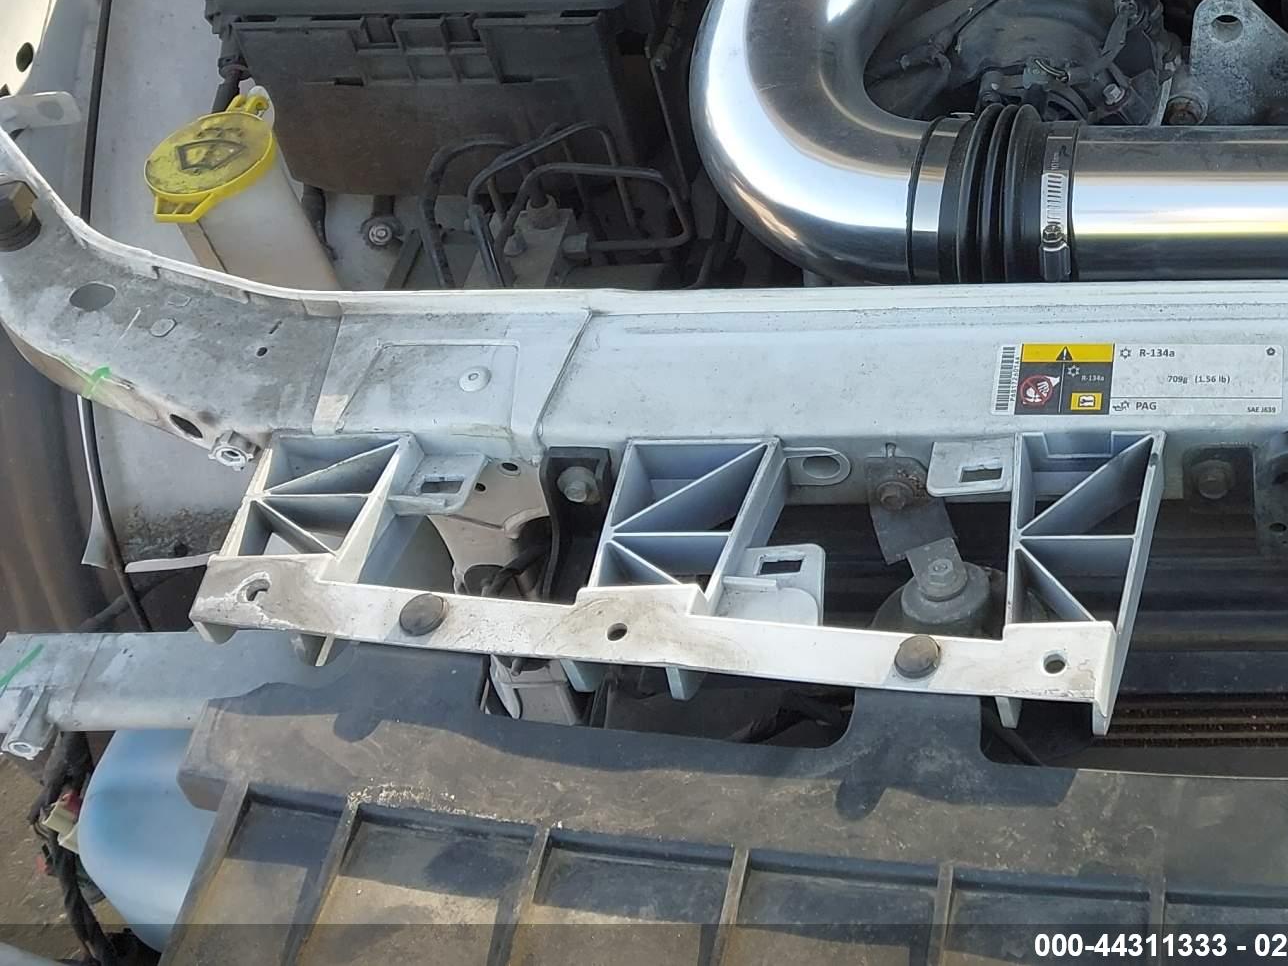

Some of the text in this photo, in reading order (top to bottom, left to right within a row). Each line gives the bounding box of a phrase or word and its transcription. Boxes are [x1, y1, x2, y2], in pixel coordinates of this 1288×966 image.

[1139, 348, 1175, 358] R-134a
[1081, 374, 1105, 382] R-134a
[1167, 375, 1231, 385] 709g (1.56 lb)
[1135, 401, 1157, 411] PAG
